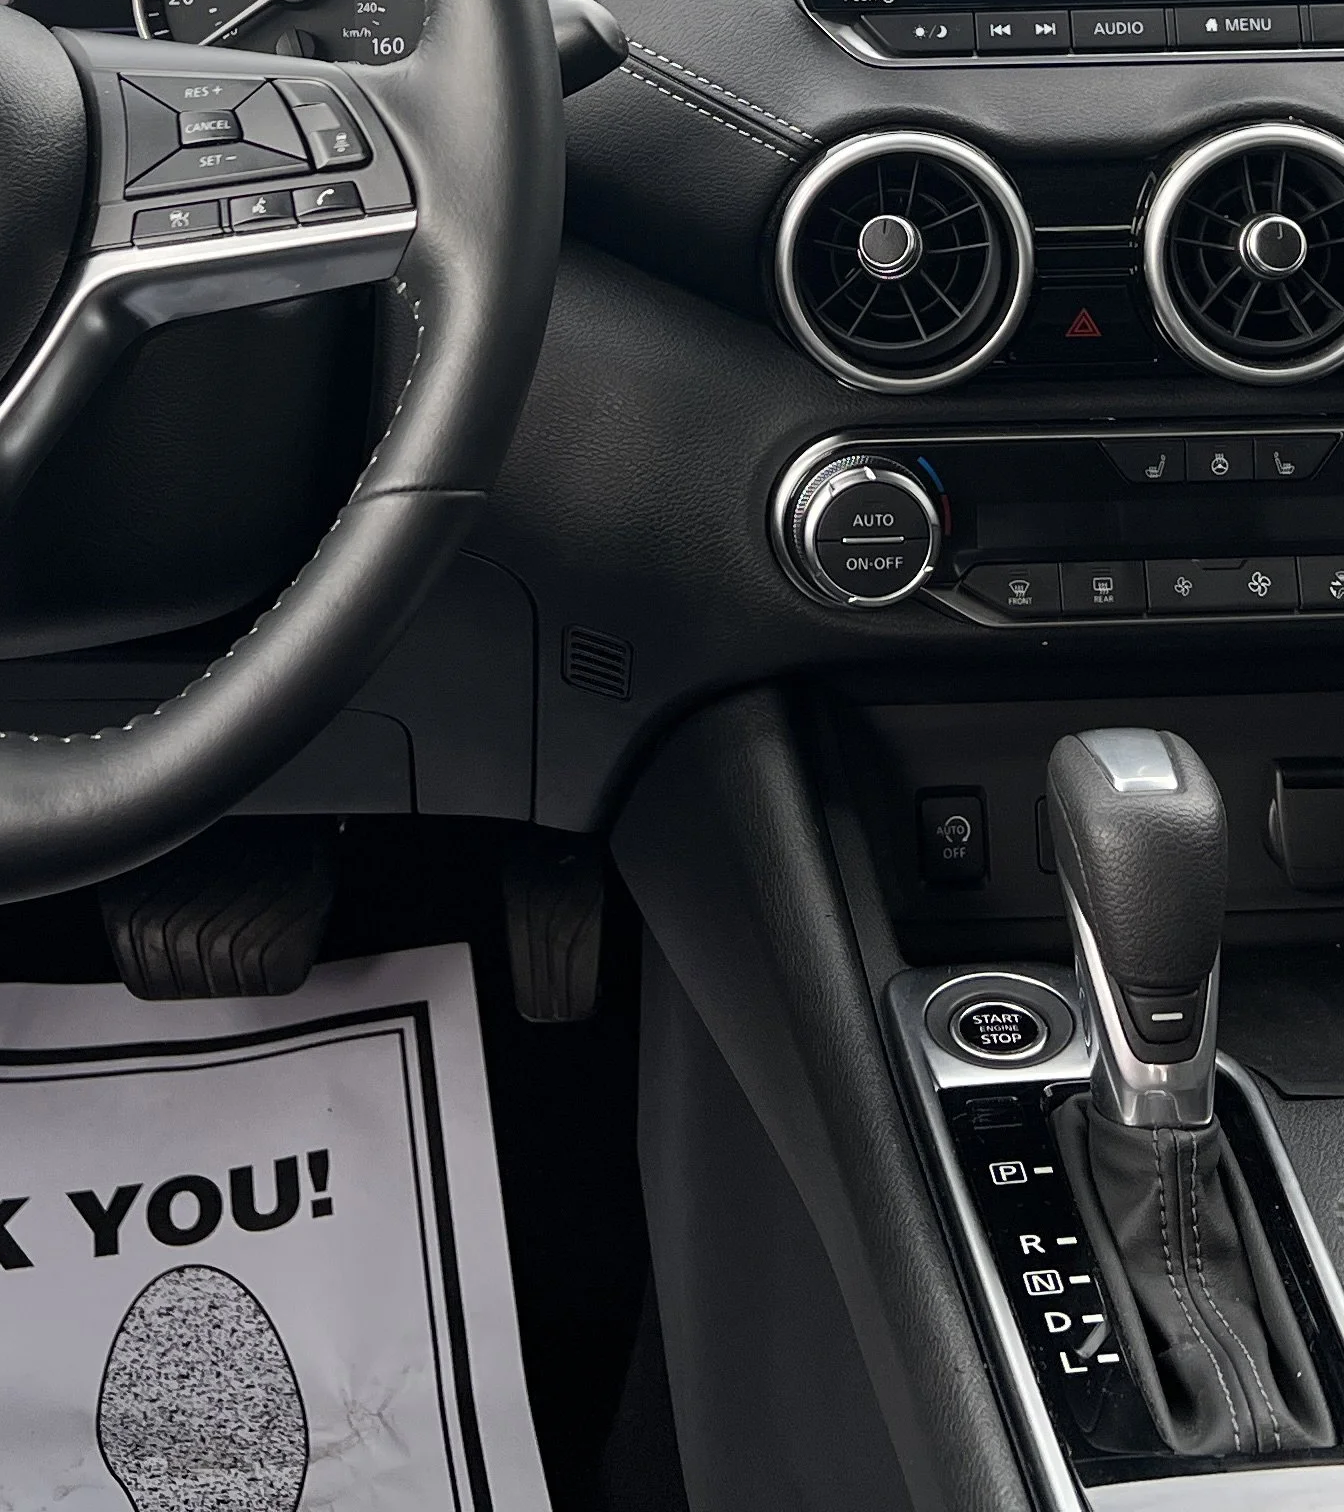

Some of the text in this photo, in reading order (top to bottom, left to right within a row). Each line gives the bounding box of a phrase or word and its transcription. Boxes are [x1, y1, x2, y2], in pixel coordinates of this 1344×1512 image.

[357, 2, 377, 14] 240
[342, 26, 372, 38] km/h
[1093, 20, 1145, 36] AUDIO
[1224, 17, 1273, 33] MENU
[371, 37, 405, 55] 160
[184, 87, 209, 99] RES
[184, 119, 231, 134] CANCEL
[199, 154, 223, 168] SET
[852, 513, 895, 528] AUTO
[1008, 596, 1033, 606] FRONT
[1093, 595, 1114, 604] REAR
[936, 824, 965, 836] AUTO
[943, 847, 967, 860] OFF
[972, 1013, 1021, 1025] START
[979, 1024, 1020, 1033] ENGINE
[980, 1033, 1022, 1045] STOP
[999, 1165, 1017, 1182] P
[64, 1148, 335, 1258] YOU!
[1019, 1234, 1046, 1255] R
[1031, 1273, 1056, 1292] N
[1044, 1311, 1072, 1333] D
[1059, 1351, 1088, 1374] L
